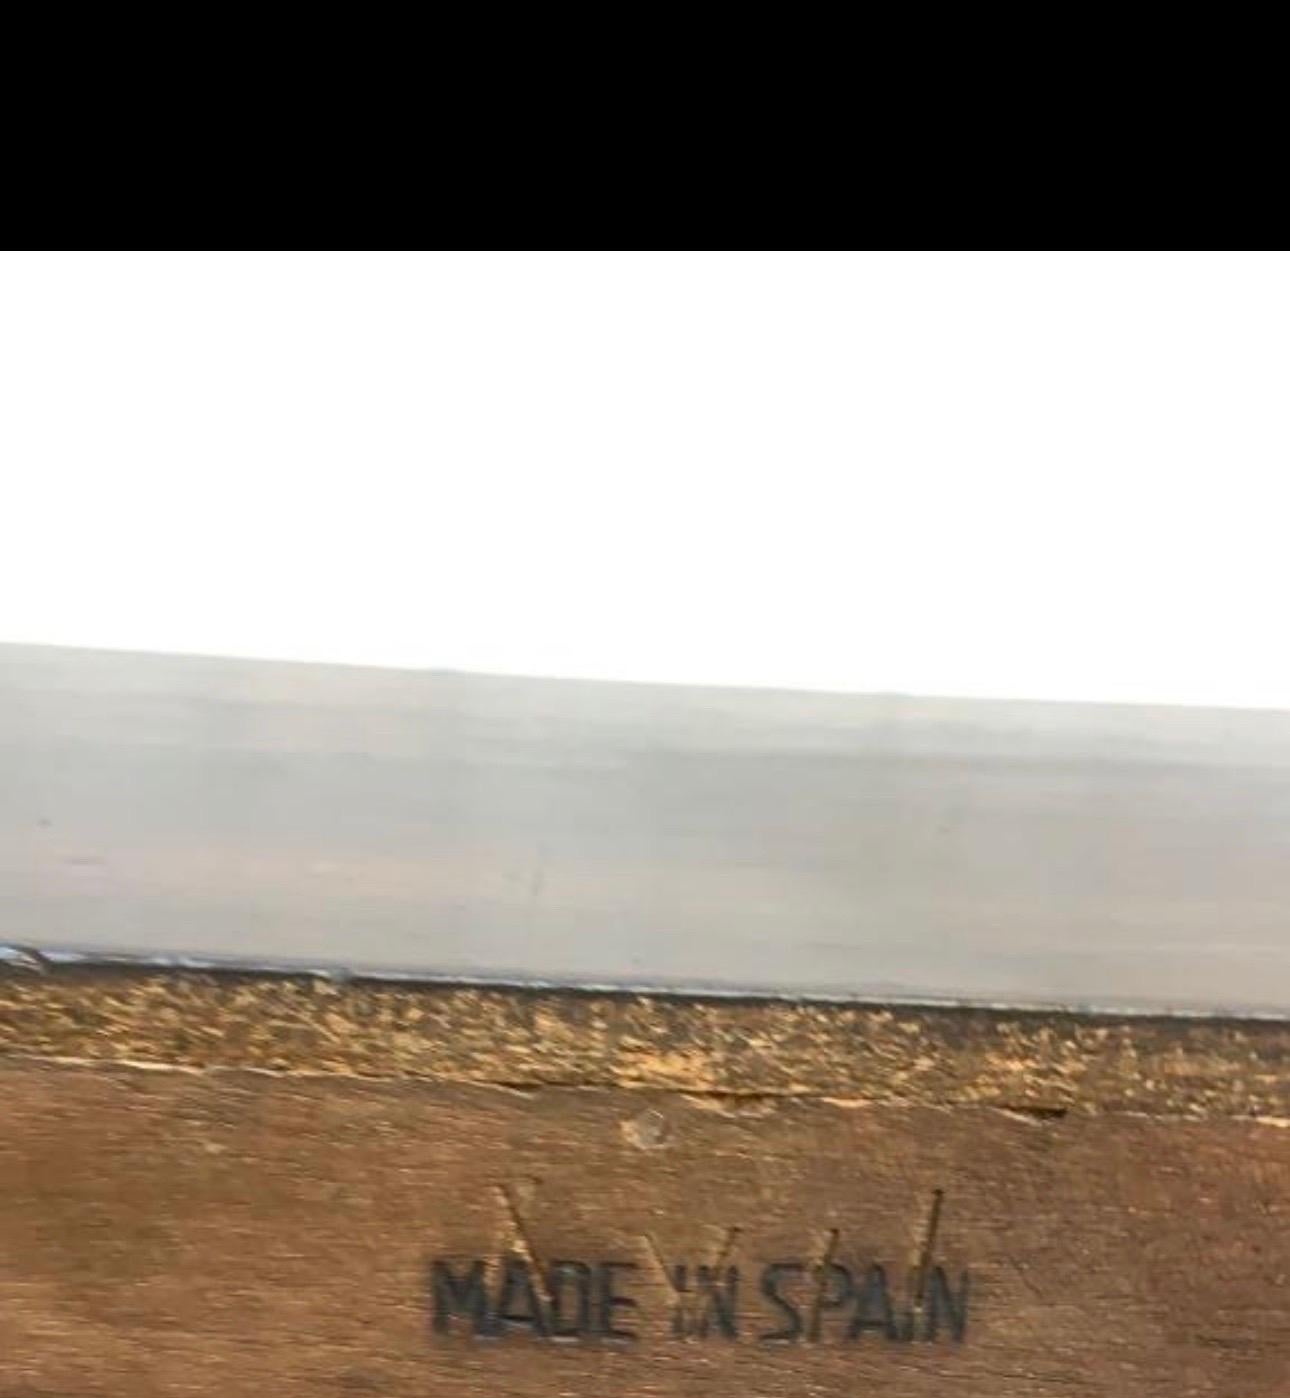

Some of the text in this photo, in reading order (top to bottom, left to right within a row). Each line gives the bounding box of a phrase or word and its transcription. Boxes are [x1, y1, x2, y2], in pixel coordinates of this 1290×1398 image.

[431, 1259, 970, 1343] MADE IN SPAIN
